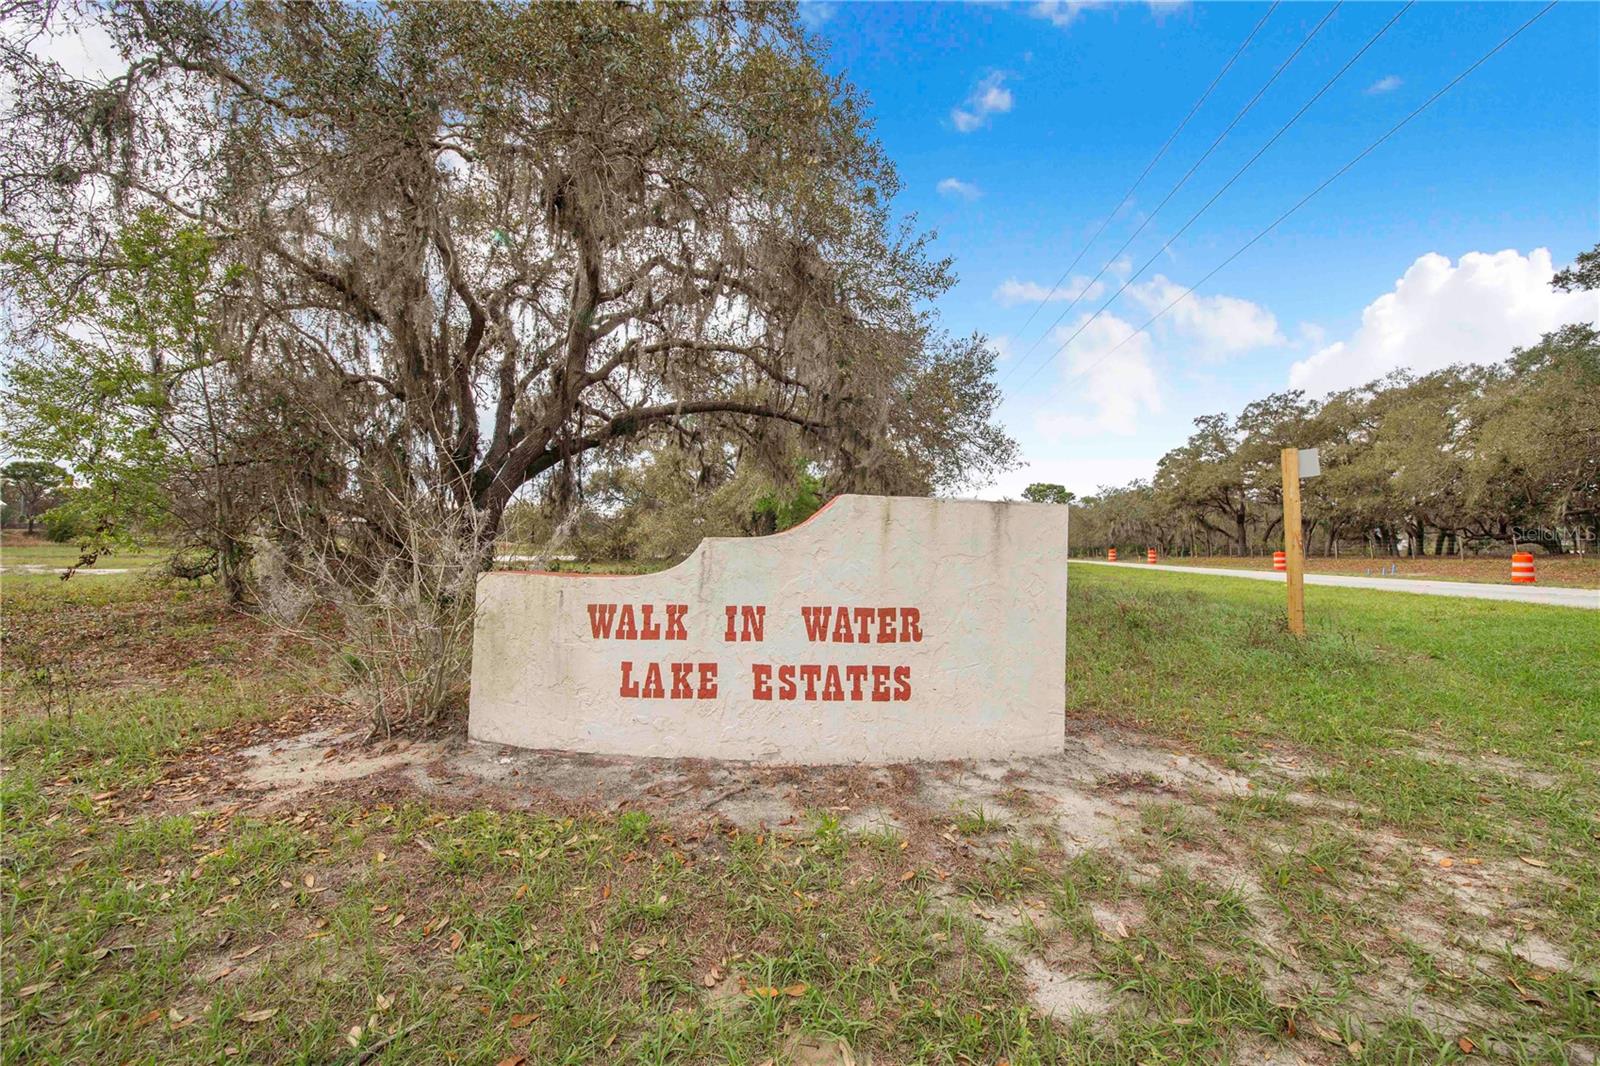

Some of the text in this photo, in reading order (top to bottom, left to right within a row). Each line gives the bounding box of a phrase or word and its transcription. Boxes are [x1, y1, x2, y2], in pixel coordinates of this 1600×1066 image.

[587, 603, 923, 644] WALK IN WATER
[619, 660, 912, 702] LAKE ESTATES
